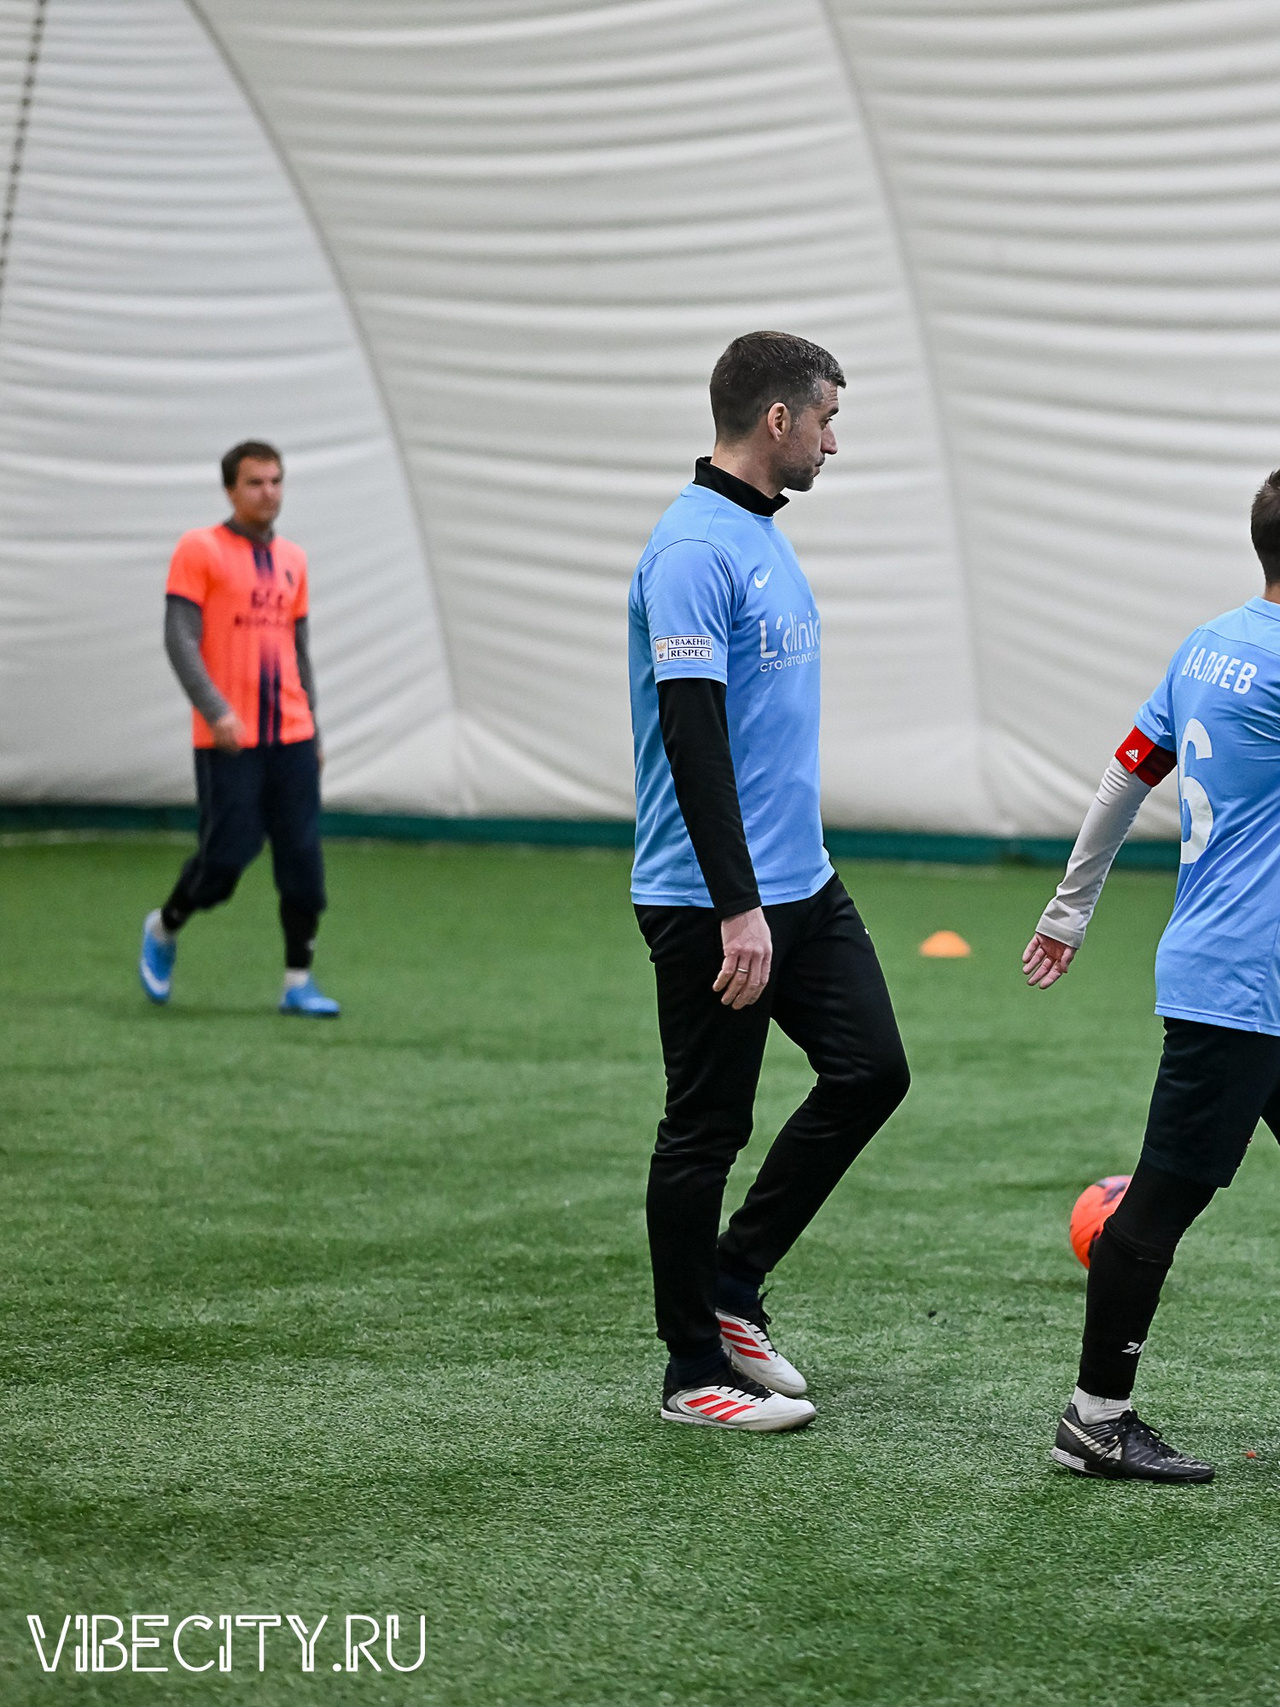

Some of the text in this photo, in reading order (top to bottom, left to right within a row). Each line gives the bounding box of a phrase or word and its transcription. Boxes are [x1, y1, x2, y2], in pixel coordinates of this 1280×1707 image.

[670, 638, 711, 647] УВАЖЕНИЕ
[671, 649, 711, 657] RESPECT
[1180, 718, 1214, 864] 6
